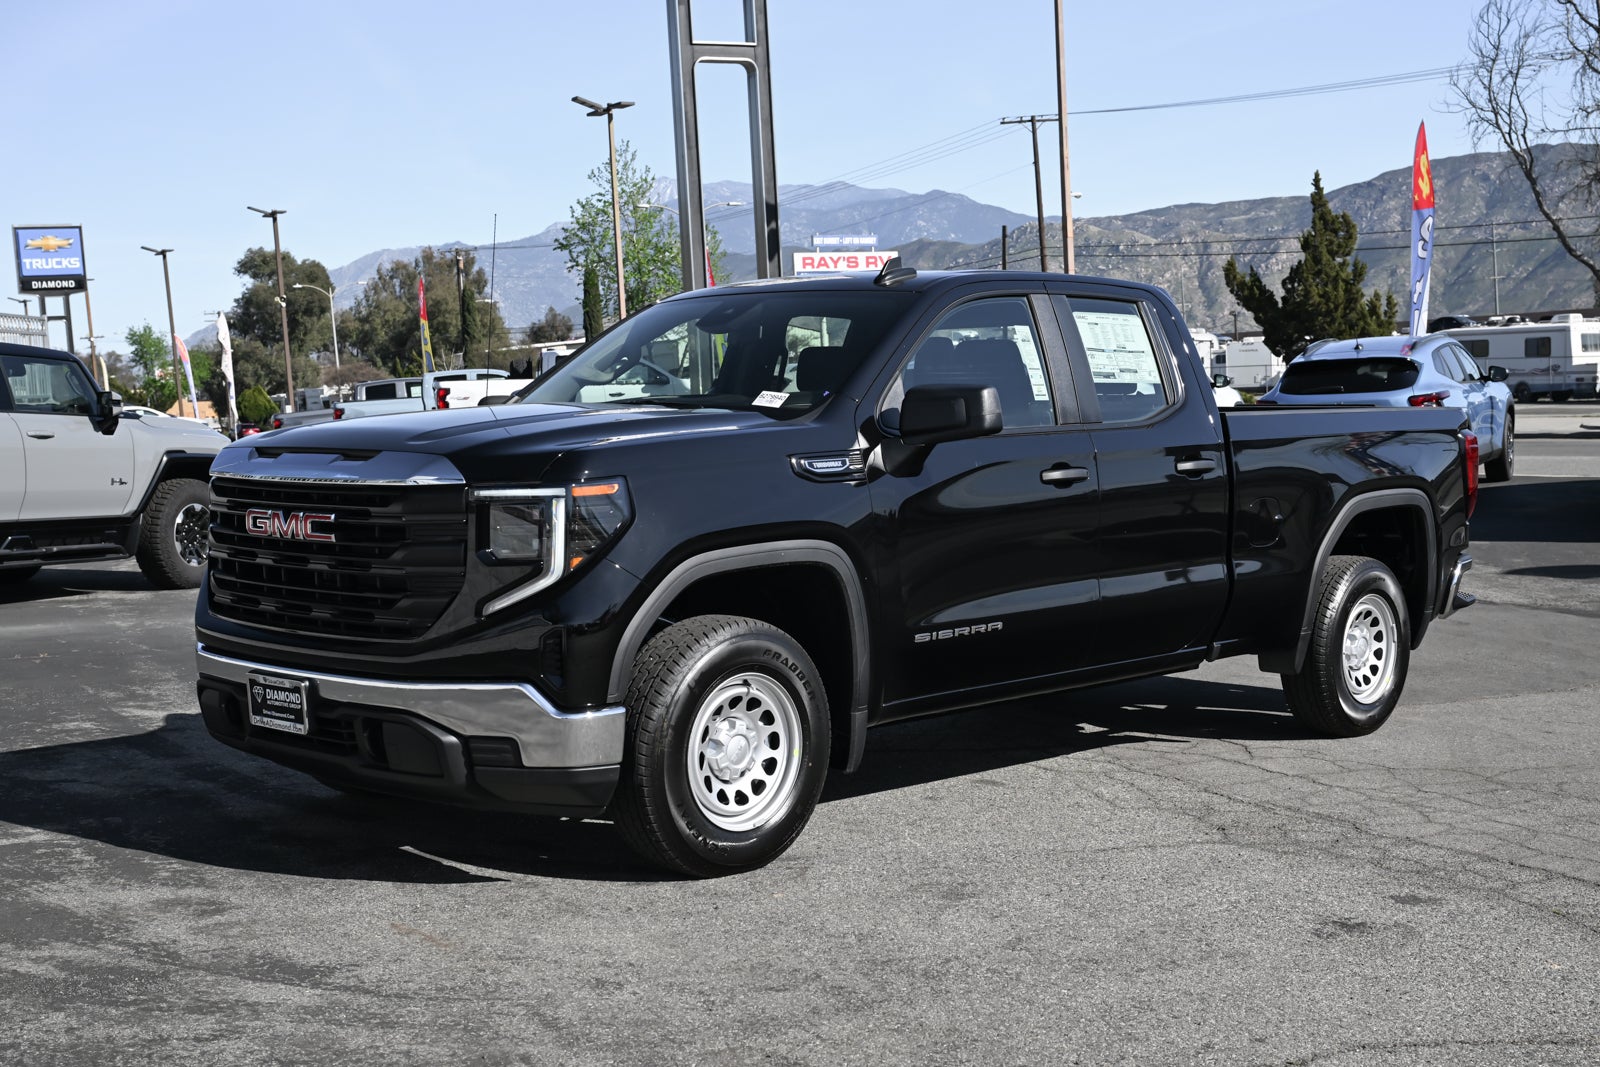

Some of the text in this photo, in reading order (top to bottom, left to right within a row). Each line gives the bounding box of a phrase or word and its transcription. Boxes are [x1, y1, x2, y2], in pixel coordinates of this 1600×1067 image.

[23, 257, 80, 270] TRUCKS
[802, 256, 859, 269] RAY'S
[31, 280, 76, 289] DIAMOND
[245, 508, 336, 542] GMC
[914, 621, 1003, 643] SIERRA
[266, 689, 301, 703] DIAMOND
